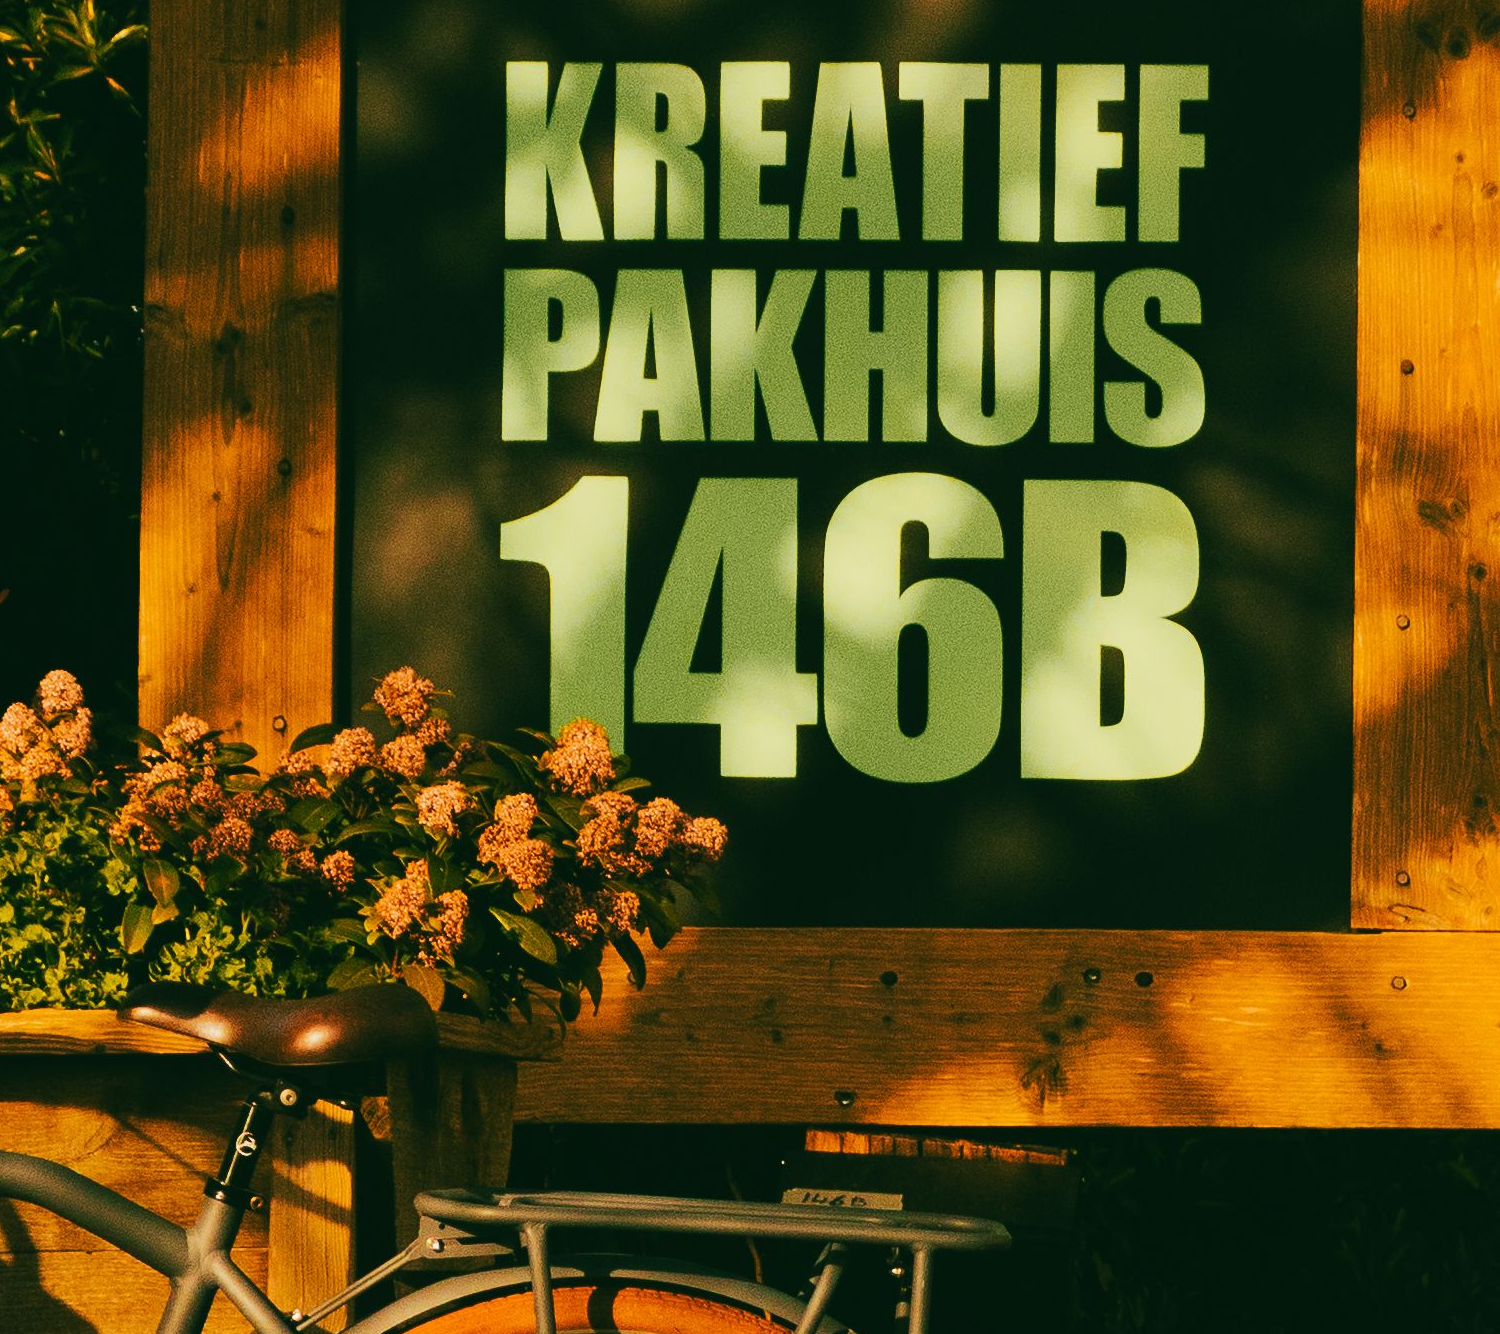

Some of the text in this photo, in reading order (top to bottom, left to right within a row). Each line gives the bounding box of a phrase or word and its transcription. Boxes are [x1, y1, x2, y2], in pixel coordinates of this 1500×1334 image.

[503, 60, 1211, 244] KREATIEF
[500, 267, 1207, 449] PAKHUIS
[499, 471, 1207, 785] 146B
